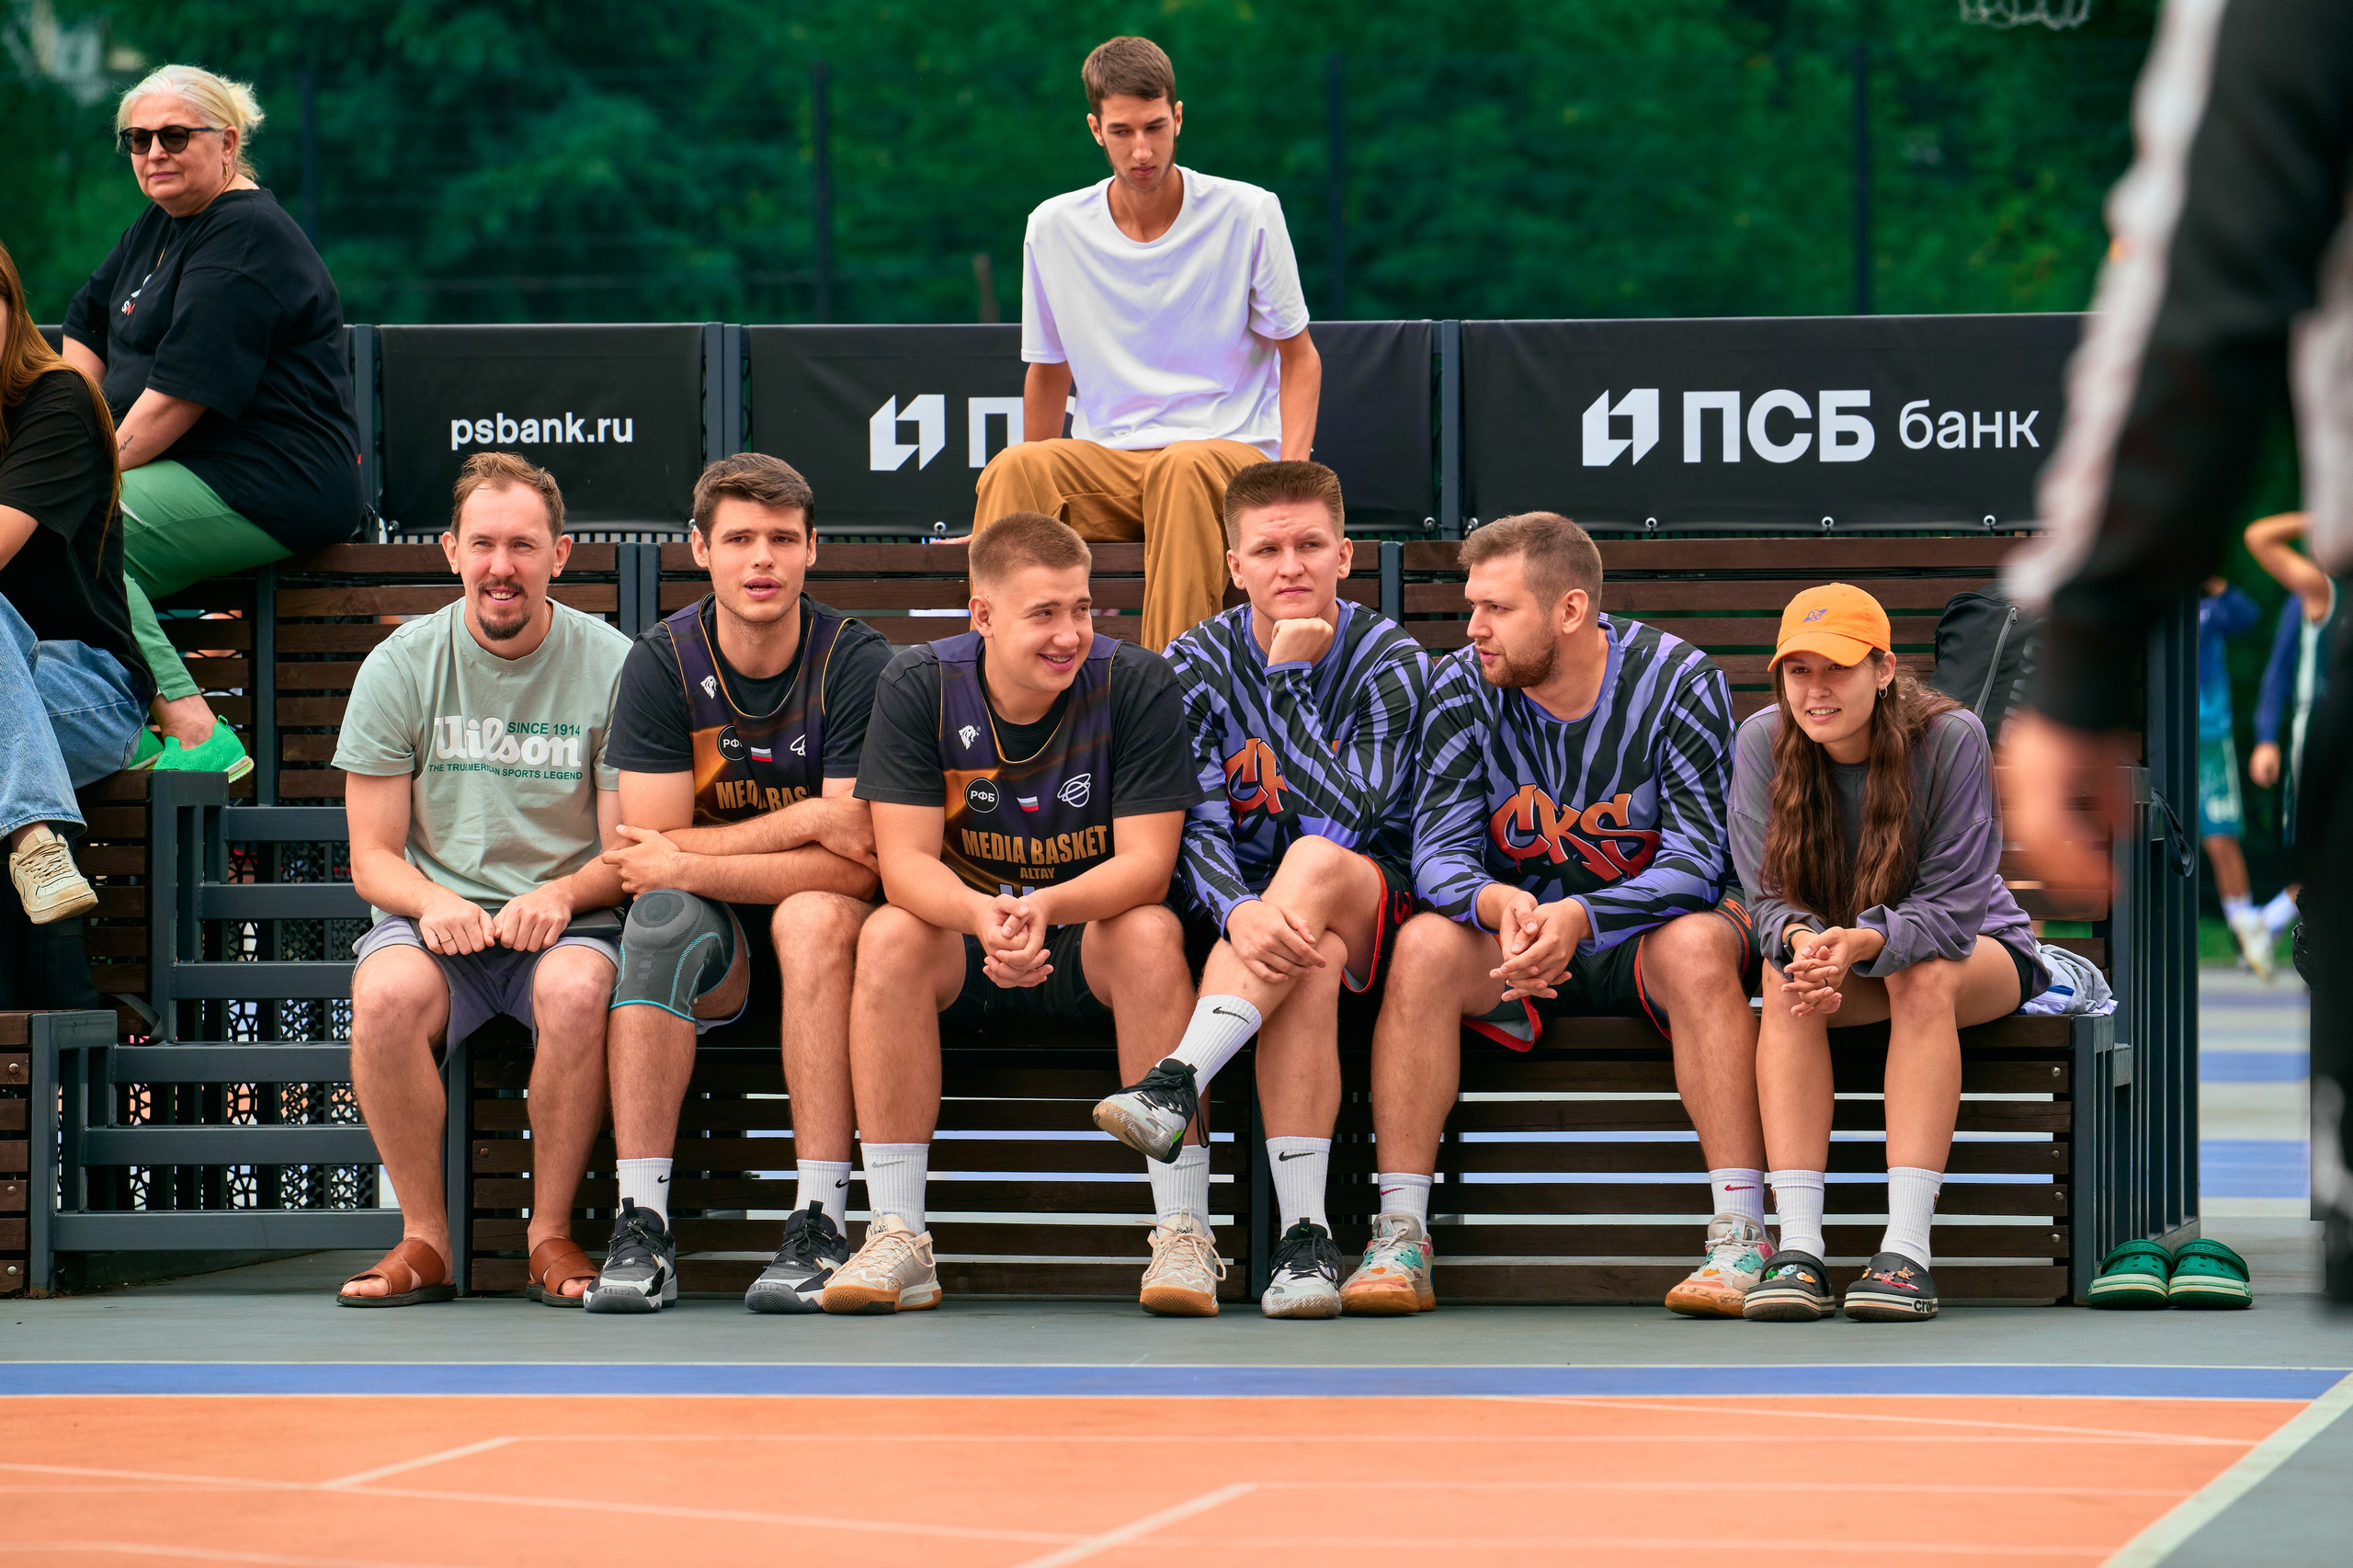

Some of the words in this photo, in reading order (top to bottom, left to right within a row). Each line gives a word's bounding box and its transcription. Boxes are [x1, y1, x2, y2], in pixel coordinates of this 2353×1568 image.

[450, 412, 634, 450] psbank.ru
[1683, 390, 1876, 463] ПСБ
[1899, 400, 2040, 449] банк
[507, 722, 549, 734] SINCE
[553, 723, 581, 736] 1914
[434, 715, 582, 767] Wilson
[722, 738, 743, 749] РФ
[428, 764, 445, 772] THE
[502, 768, 540, 778] SPORTS
[543, 771, 583, 780] LEGEND
[970, 790, 995, 802] РФБ
[961, 828, 1028, 865] MEDIA
[1030, 825, 1108, 865] BASKET
[1019, 867, 1055, 880] ALTAY
